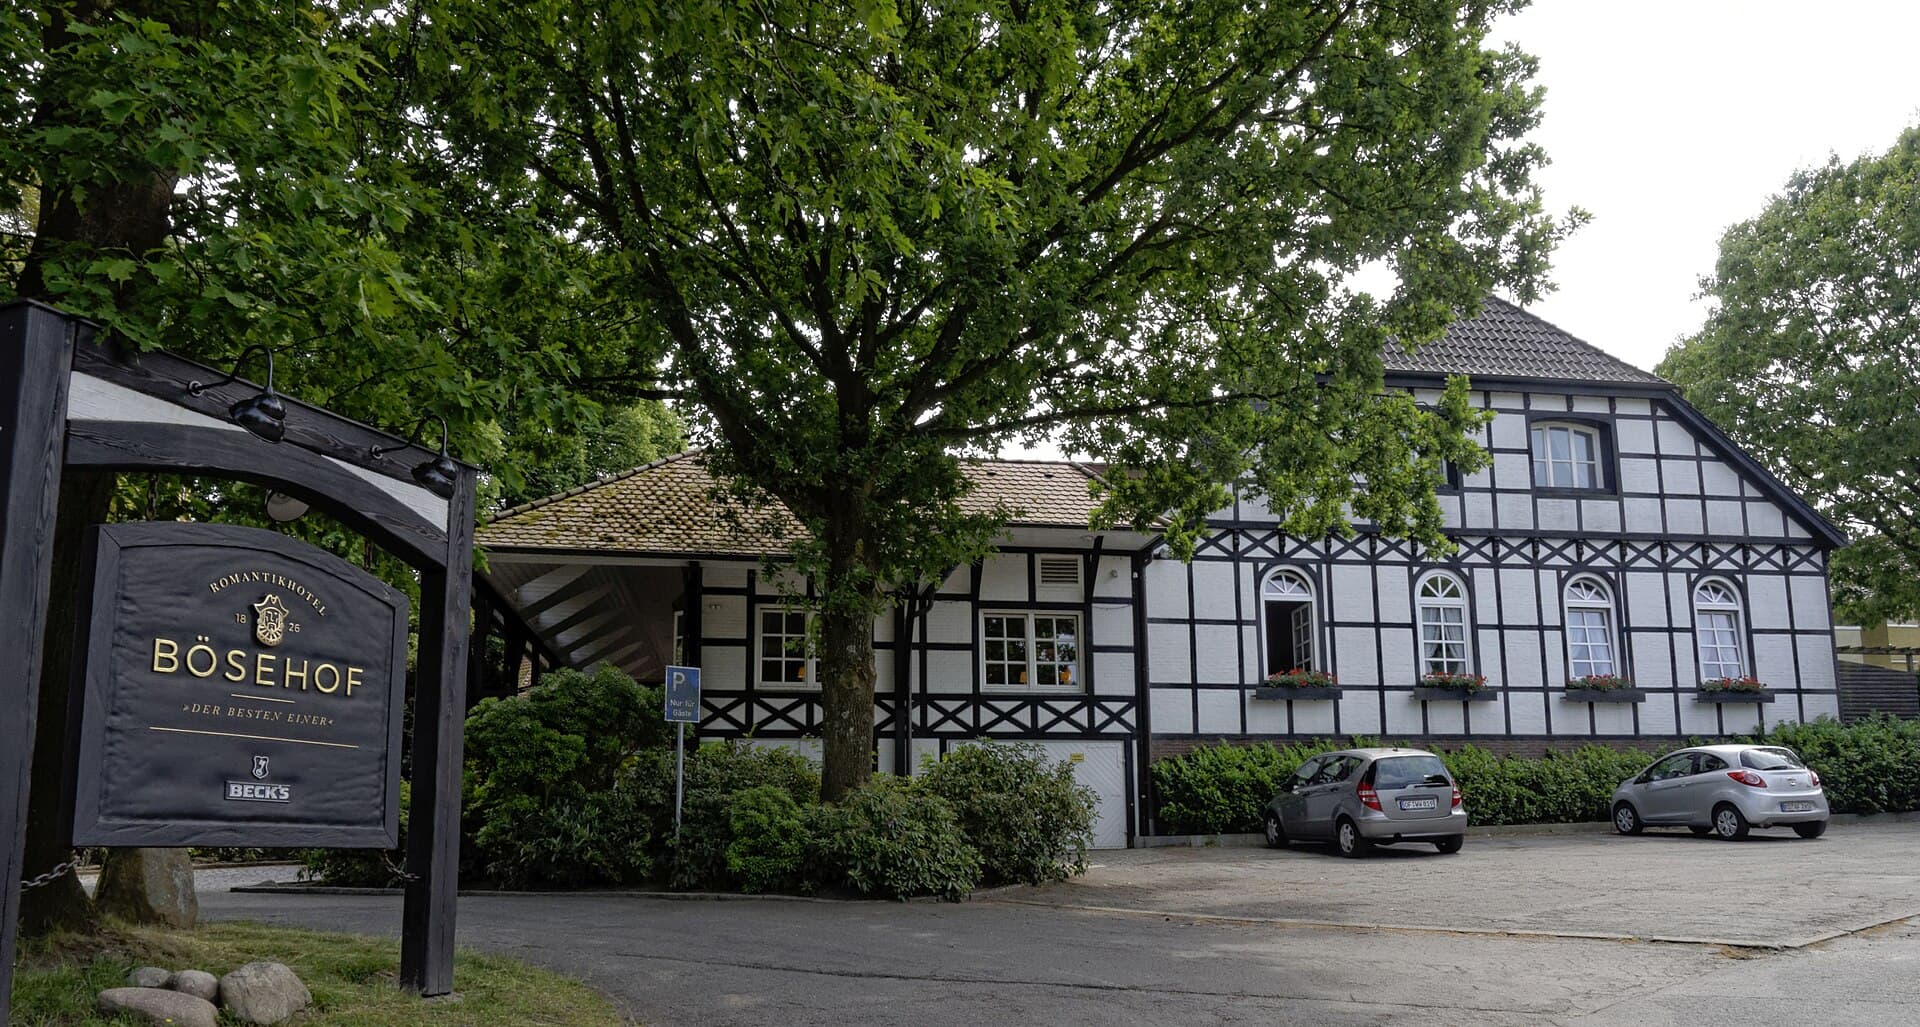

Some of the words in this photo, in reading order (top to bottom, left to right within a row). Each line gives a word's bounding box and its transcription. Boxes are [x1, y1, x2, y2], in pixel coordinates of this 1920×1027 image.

[209, 570, 328, 617] ROMANTIKHOTEL
[235, 612, 247, 625] 18
[288, 622, 301, 633] 26
[152, 635, 364, 697] BÖSEHOF
[673, 671, 686, 691] P
[670, 699, 682, 707] Nur
[228, 707, 282, 722] BESTEN
[228, 783, 290, 800] BECK'S
